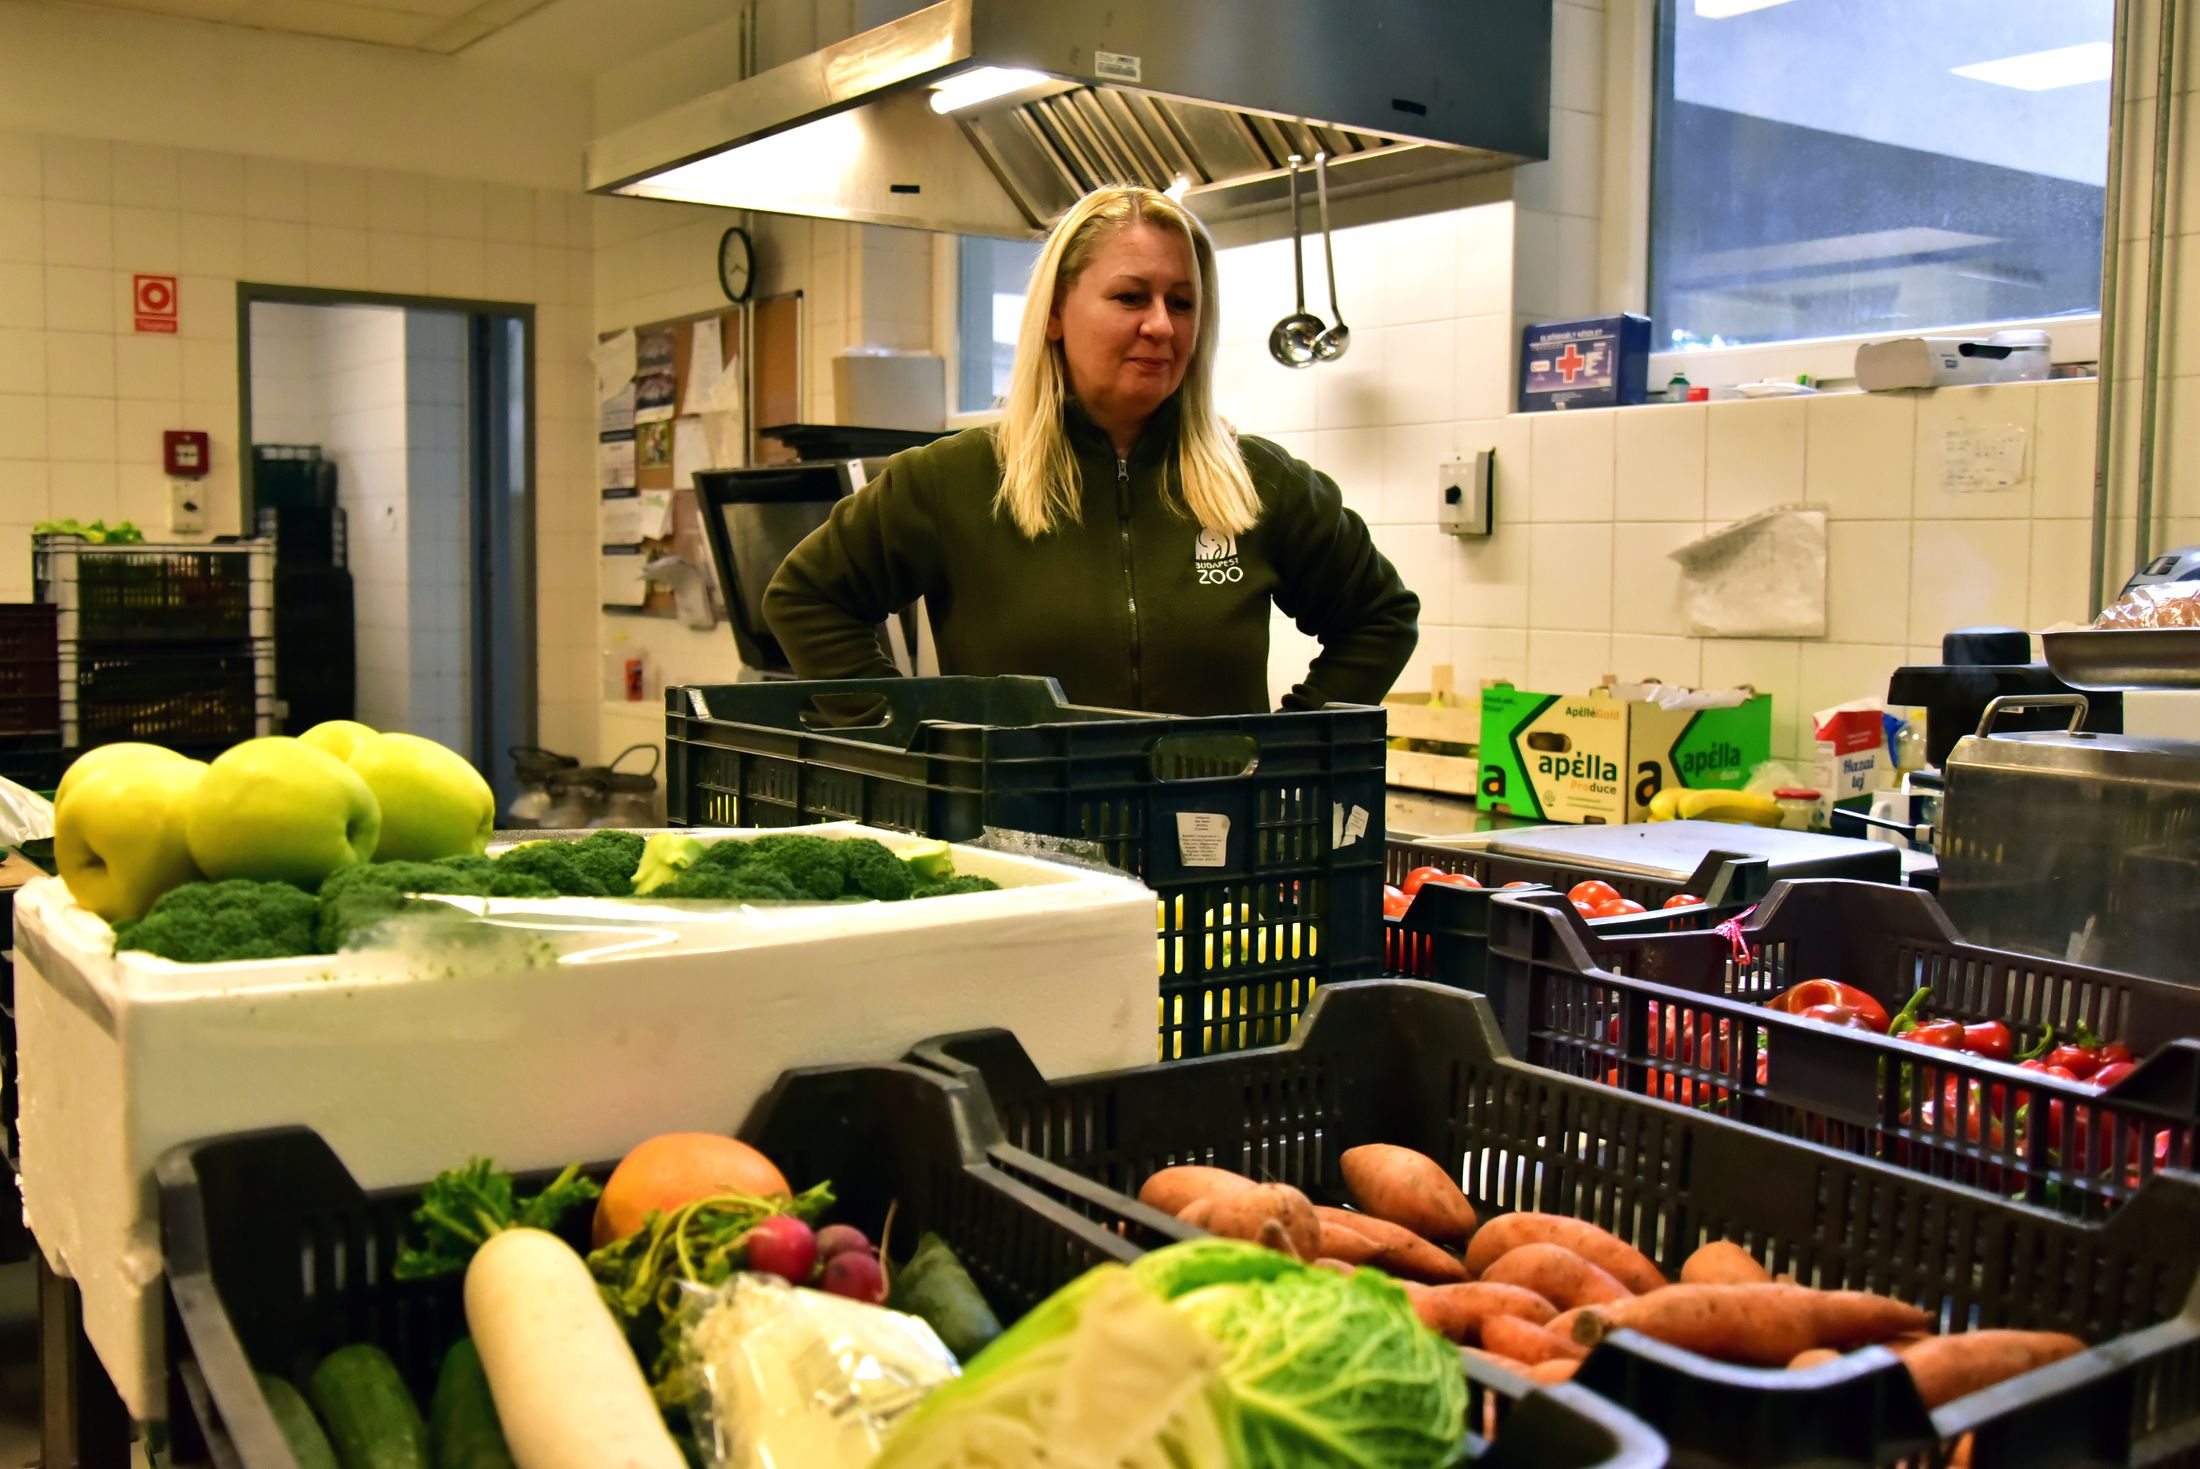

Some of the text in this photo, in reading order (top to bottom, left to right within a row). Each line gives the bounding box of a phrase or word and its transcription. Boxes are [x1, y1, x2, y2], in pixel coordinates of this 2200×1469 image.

[1195, 556, 1239, 569] BUDAPEST
[1197, 566, 1244, 584] ZOO
[1482, 765, 1506, 797] a
[1571, 780, 1616, 795] Produce
[1635, 761, 1662, 806] a
